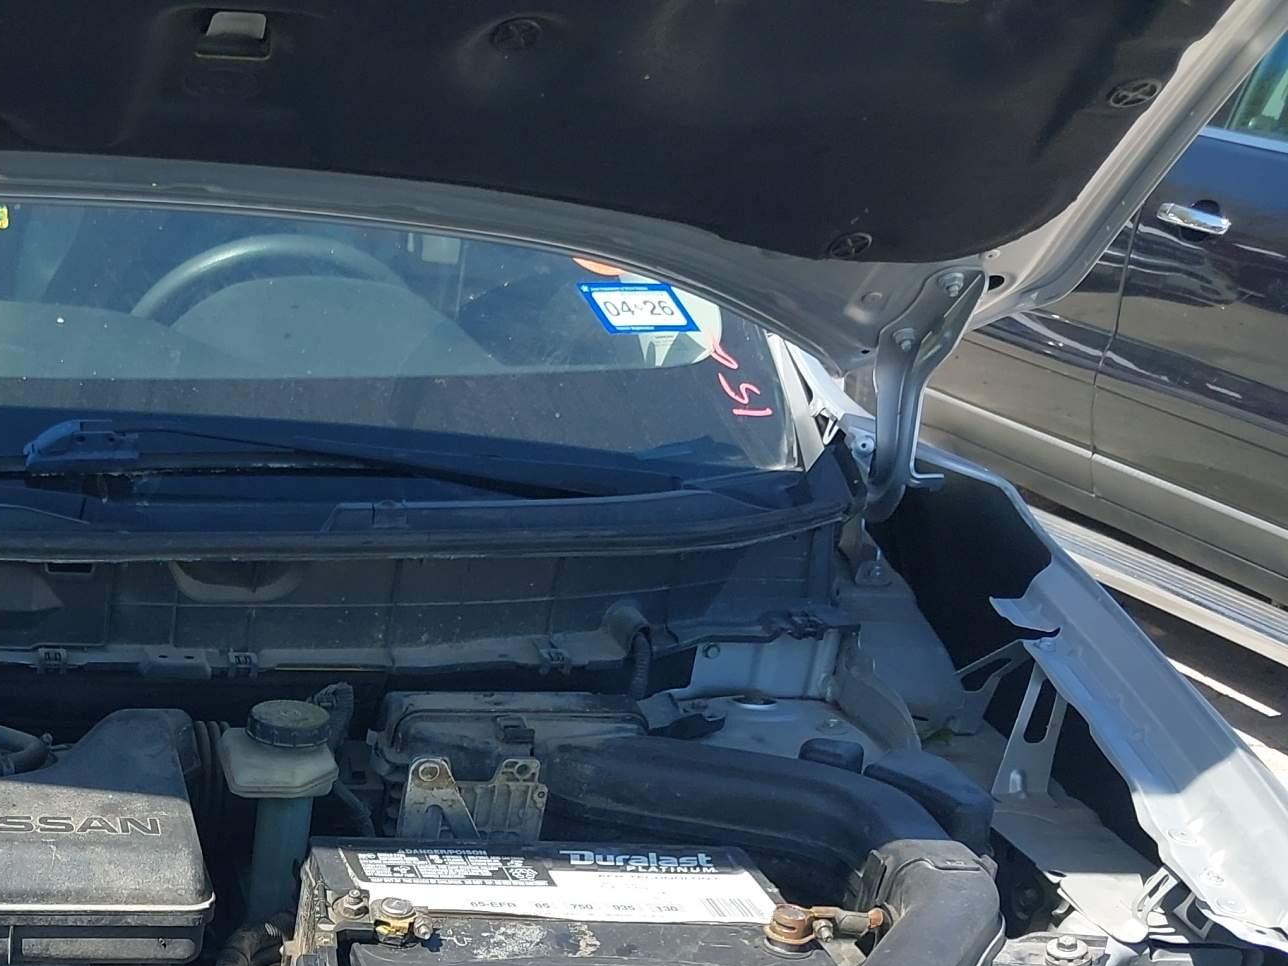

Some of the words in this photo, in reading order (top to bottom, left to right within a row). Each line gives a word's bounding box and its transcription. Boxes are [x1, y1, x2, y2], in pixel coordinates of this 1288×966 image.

[603, 300, 634, 316] 04
[643, 300, 674, 316] 26
[560, 850, 715, 867] Duralast
[626, 865, 716, 873] PLATINUM
